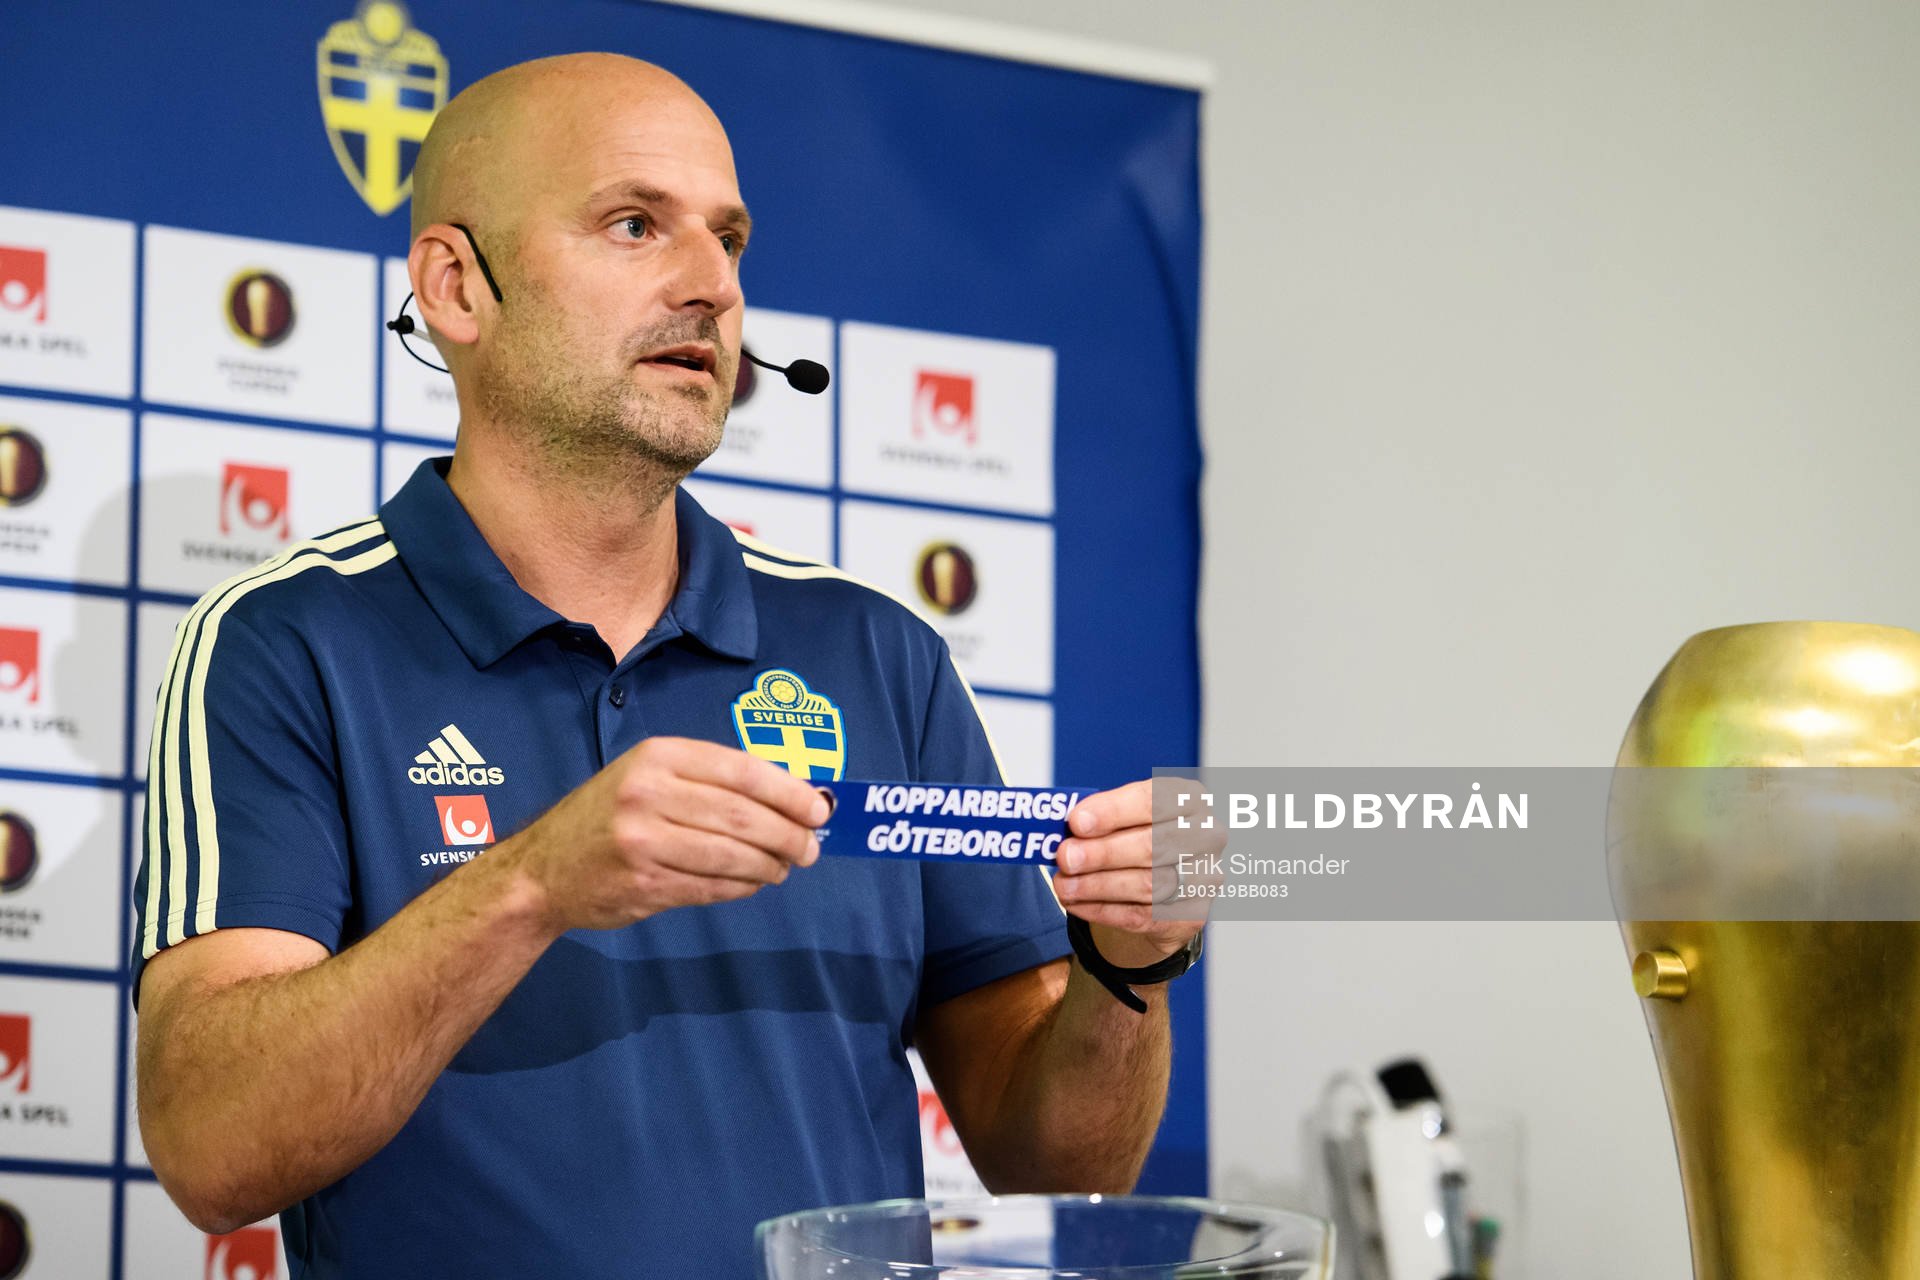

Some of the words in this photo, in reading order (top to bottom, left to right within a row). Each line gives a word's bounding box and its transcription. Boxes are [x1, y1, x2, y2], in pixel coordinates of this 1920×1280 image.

[753, 711, 824, 727] SVERIGE
[408, 762, 505, 785] adidas
[864, 784, 1078, 821] KOPPARBERGS/
[867, 819, 1022, 858] GÖTEBORG
[1023, 832, 1062, 860] FC
